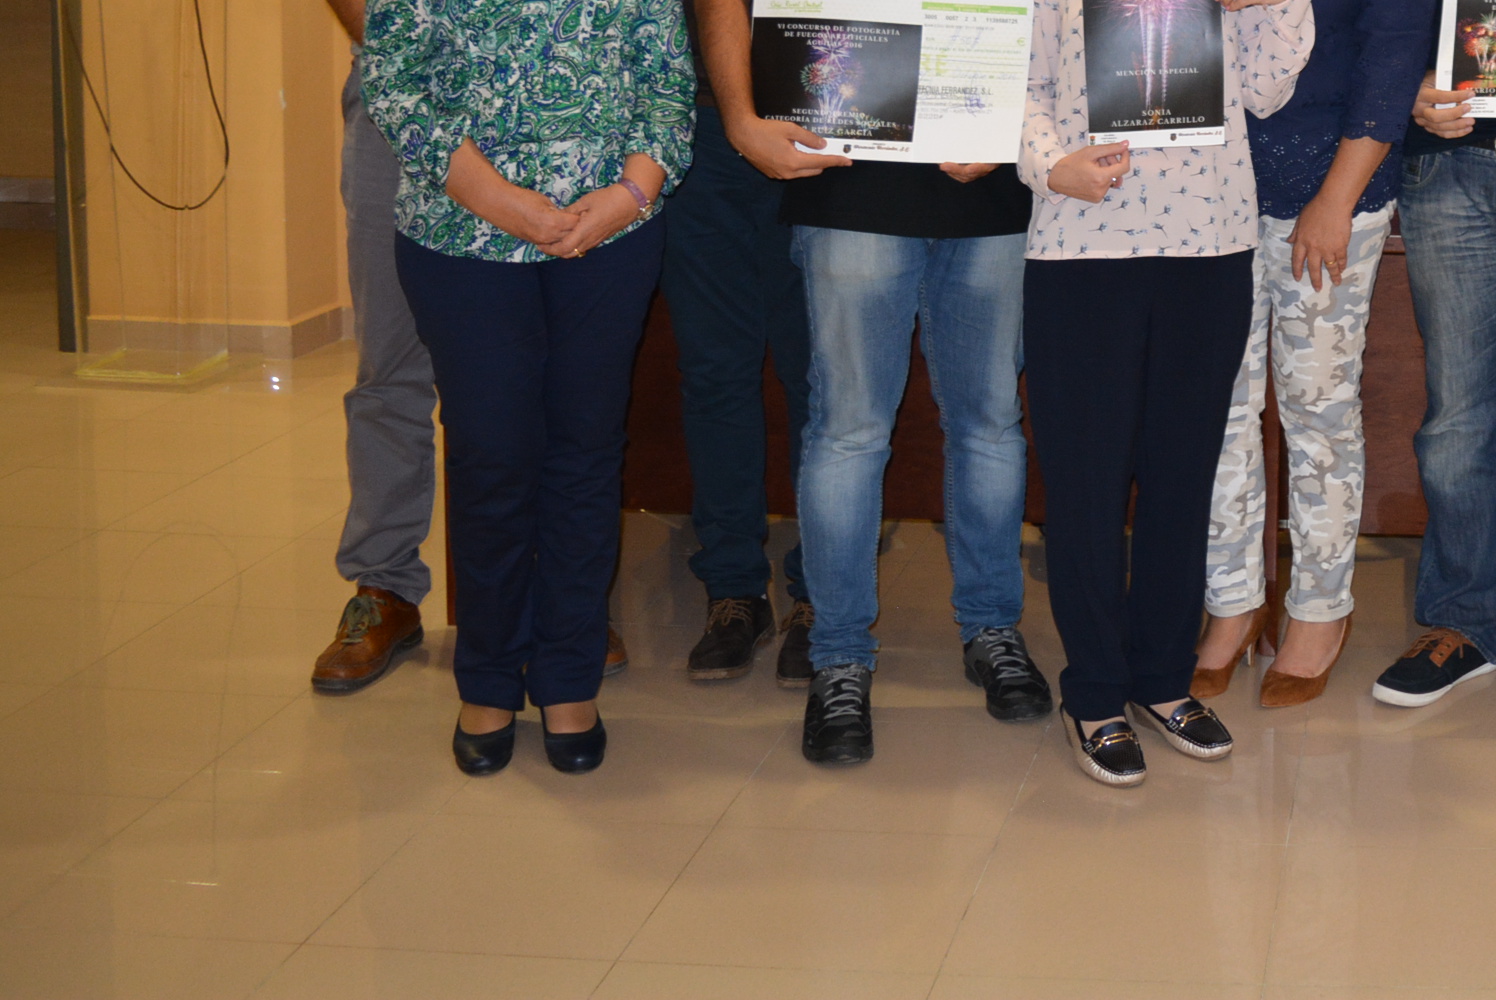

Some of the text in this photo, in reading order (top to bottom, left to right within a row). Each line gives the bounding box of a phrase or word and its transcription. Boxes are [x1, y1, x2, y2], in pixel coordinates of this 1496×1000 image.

[787, 23, 831, 31] CONCURSO
[847, 26, 901, 37] FOTOGRAFÍA
[844, 42, 863, 50] 2016
[1159, 67, 1199, 75] ESPECIAL
[1142, 109, 1171, 117] SONIA
[1112, 116, 1205, 128] ALZARAZ CARRILLO
[812, 126, 834, 135] RUIZ
[836, 128, 873, 138] GARCÍA
